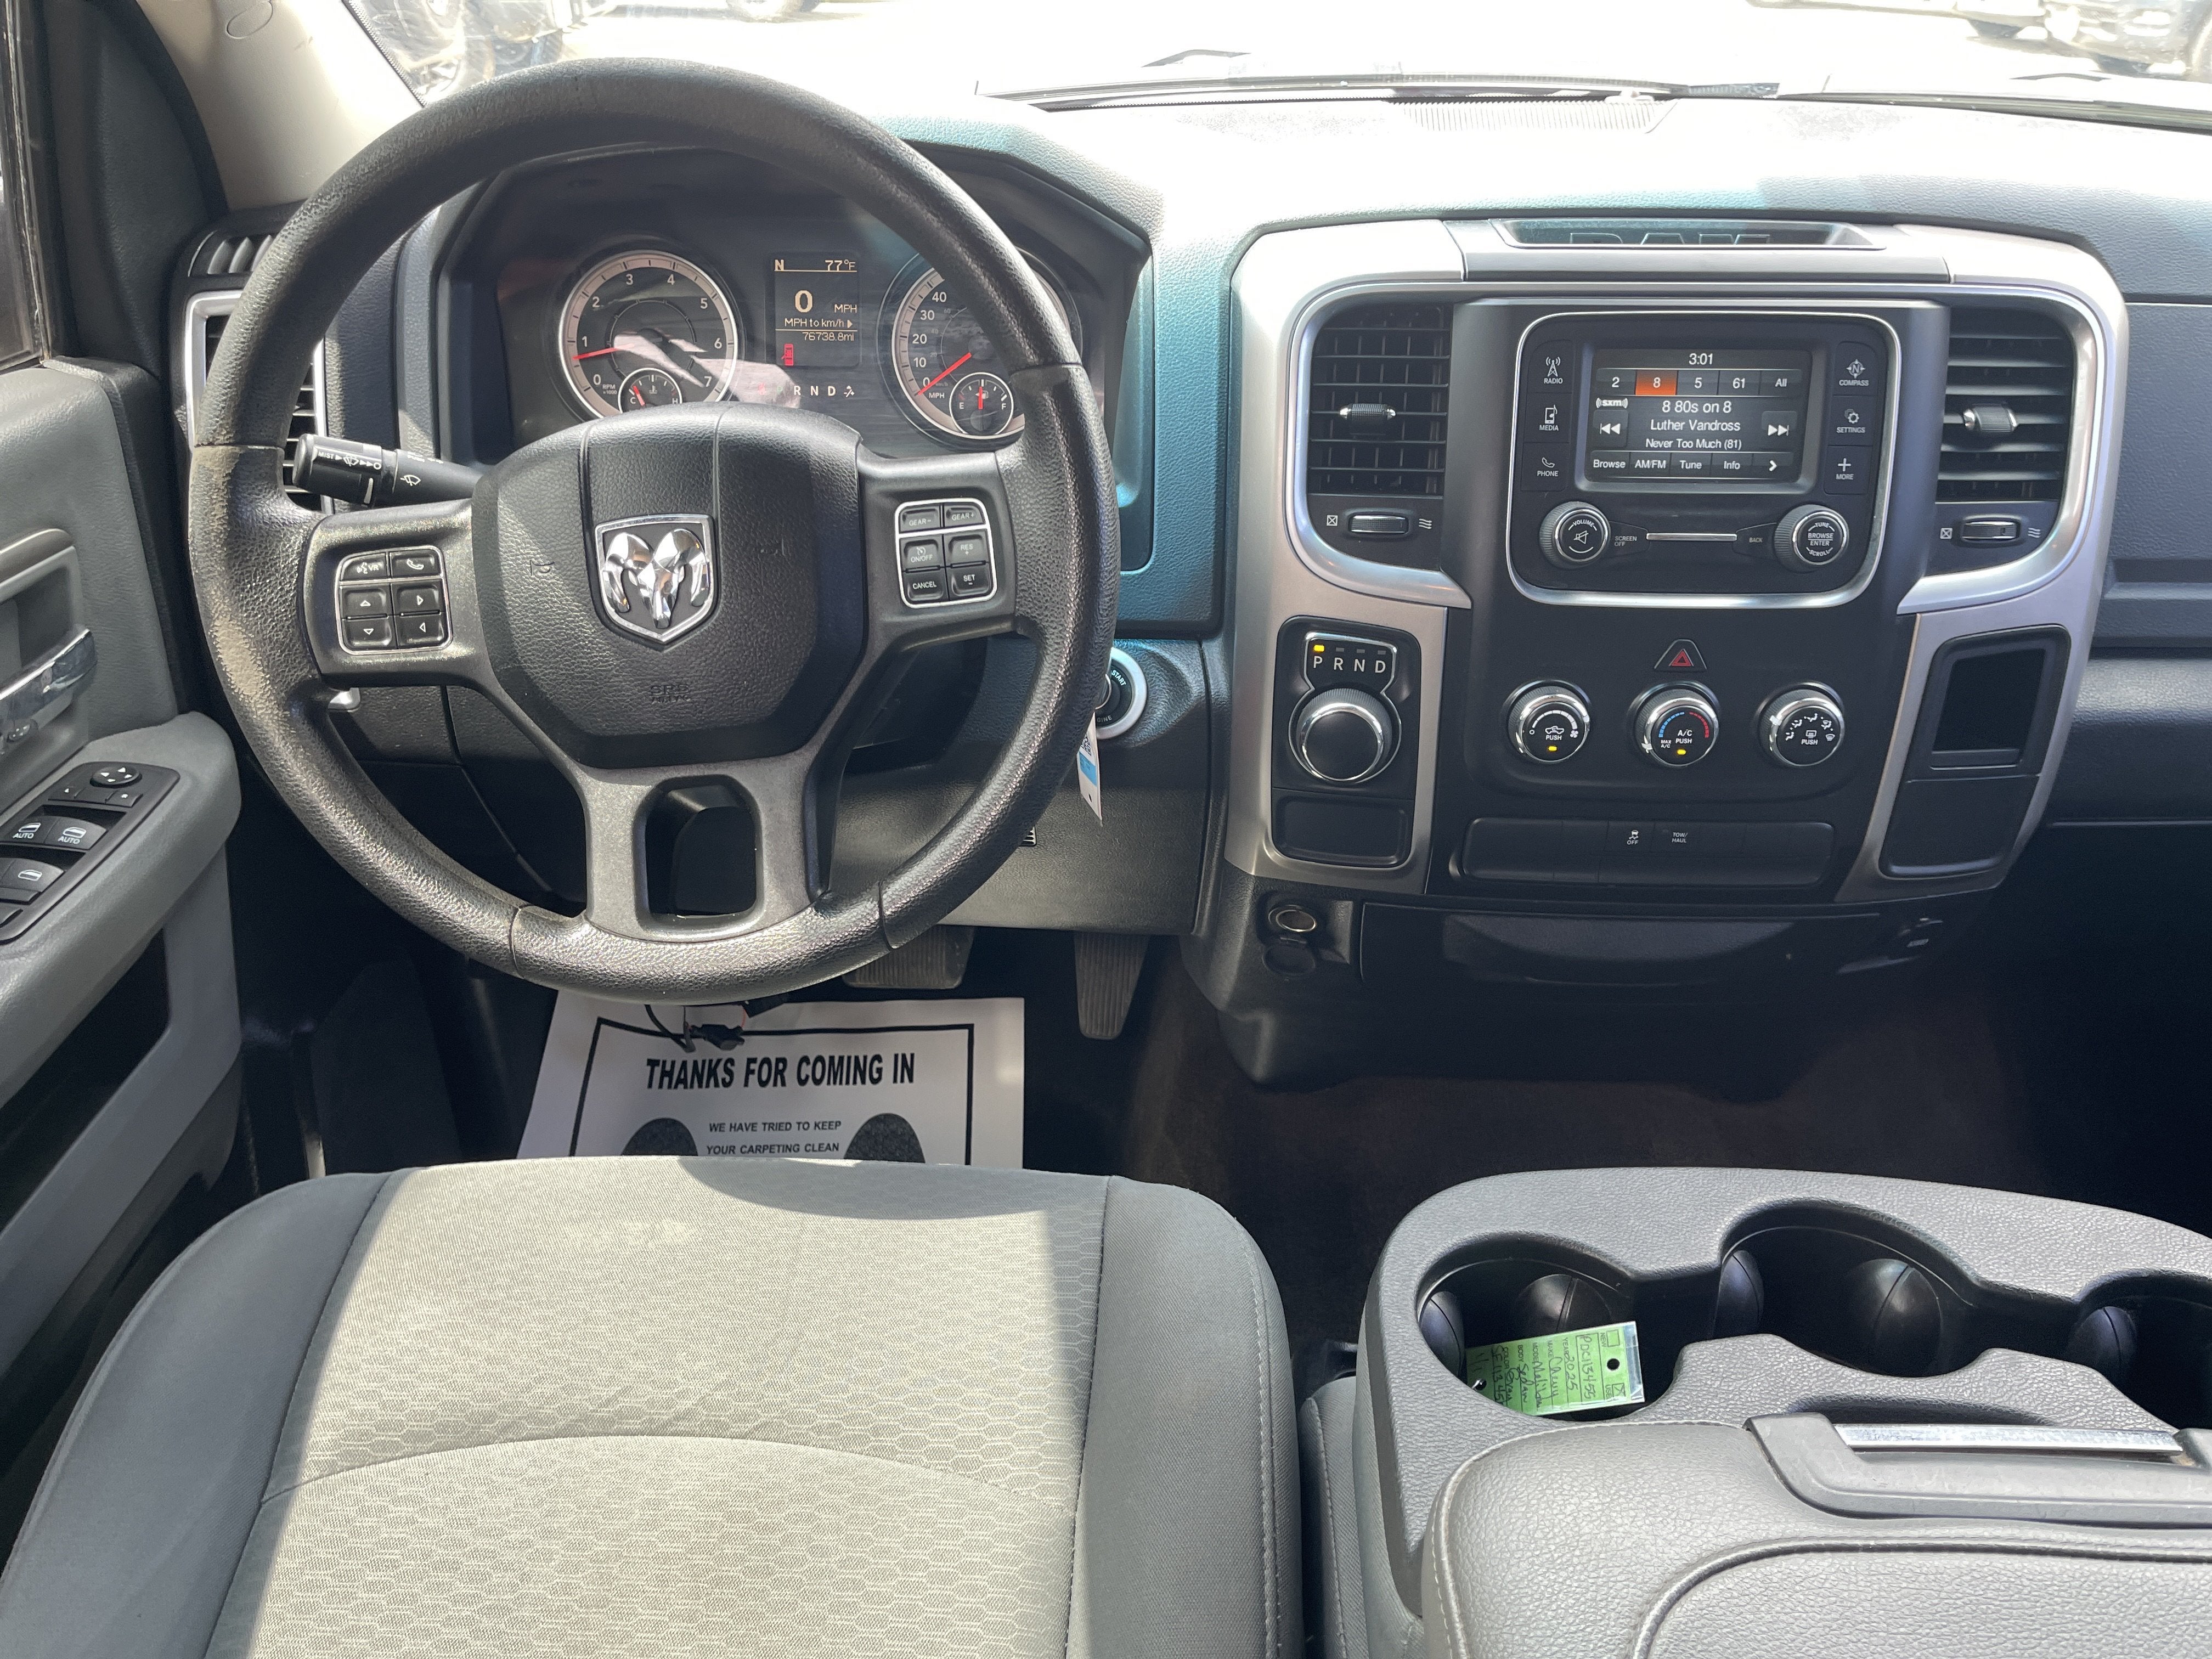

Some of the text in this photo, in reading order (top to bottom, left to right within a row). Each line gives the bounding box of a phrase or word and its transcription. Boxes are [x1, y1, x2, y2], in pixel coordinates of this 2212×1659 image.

[775, 259, 785, 271] N
[626, 274, 633, 285] 3
[667, 274, 675, 285] 4
[592, 297, 600, 307] 2
[795, 290, 857, 313] 0 MPH
[932, 292, 947, 302] 40
[700, 298, 708, 309] 5
[921, 310, 935, 320] 30
[785, 318, 807, 327] MPH
[822, 318, 844, 328] km/h
[582, 336, 587, 347] 1
[714, 338, 723, 349] 6
[912, 334, 927, 344] 20
[913, 357, 927, 368] 10
[1689, 353, 1713, 365] 3:01
[1852, 364, 1860, 373] N
[593, 374, 601, 385] 0
[704, 376, 712, 387] 7
[923, 377, 929, 387] 0
[1612, 377, 1787, 388] 2 8 5 61 All
[794, 386, 801, 395] R
[811, 386, 819, 396] N
[828, 386, 836, 396] D
[1662, 400, 1731, 413] 8 80s on 8
[1651, 419, 1740, 431] Luther Vandross
[1646, 439, 1741, 450] Never Too Much (81)
[1593, 459, 1740, 470] Browse AM/FM Tune Info
[1572, 519, 1594, 528] VOLUME
[911, 555, 933, 563] ON/OFF
[913, 582, 936, 590] CANCEL
[1313, 656, 1386, 673] P R N D
[1111, 670, 1126, 686] START
[647, 1053, 915, 1090] THANKS FOR COMING IN
[709, 1121, 842, 1132] WE HAVE TRIED TO KEEP
[707, 1143, 839, 1154] YOUR CARPETING CLEAN
